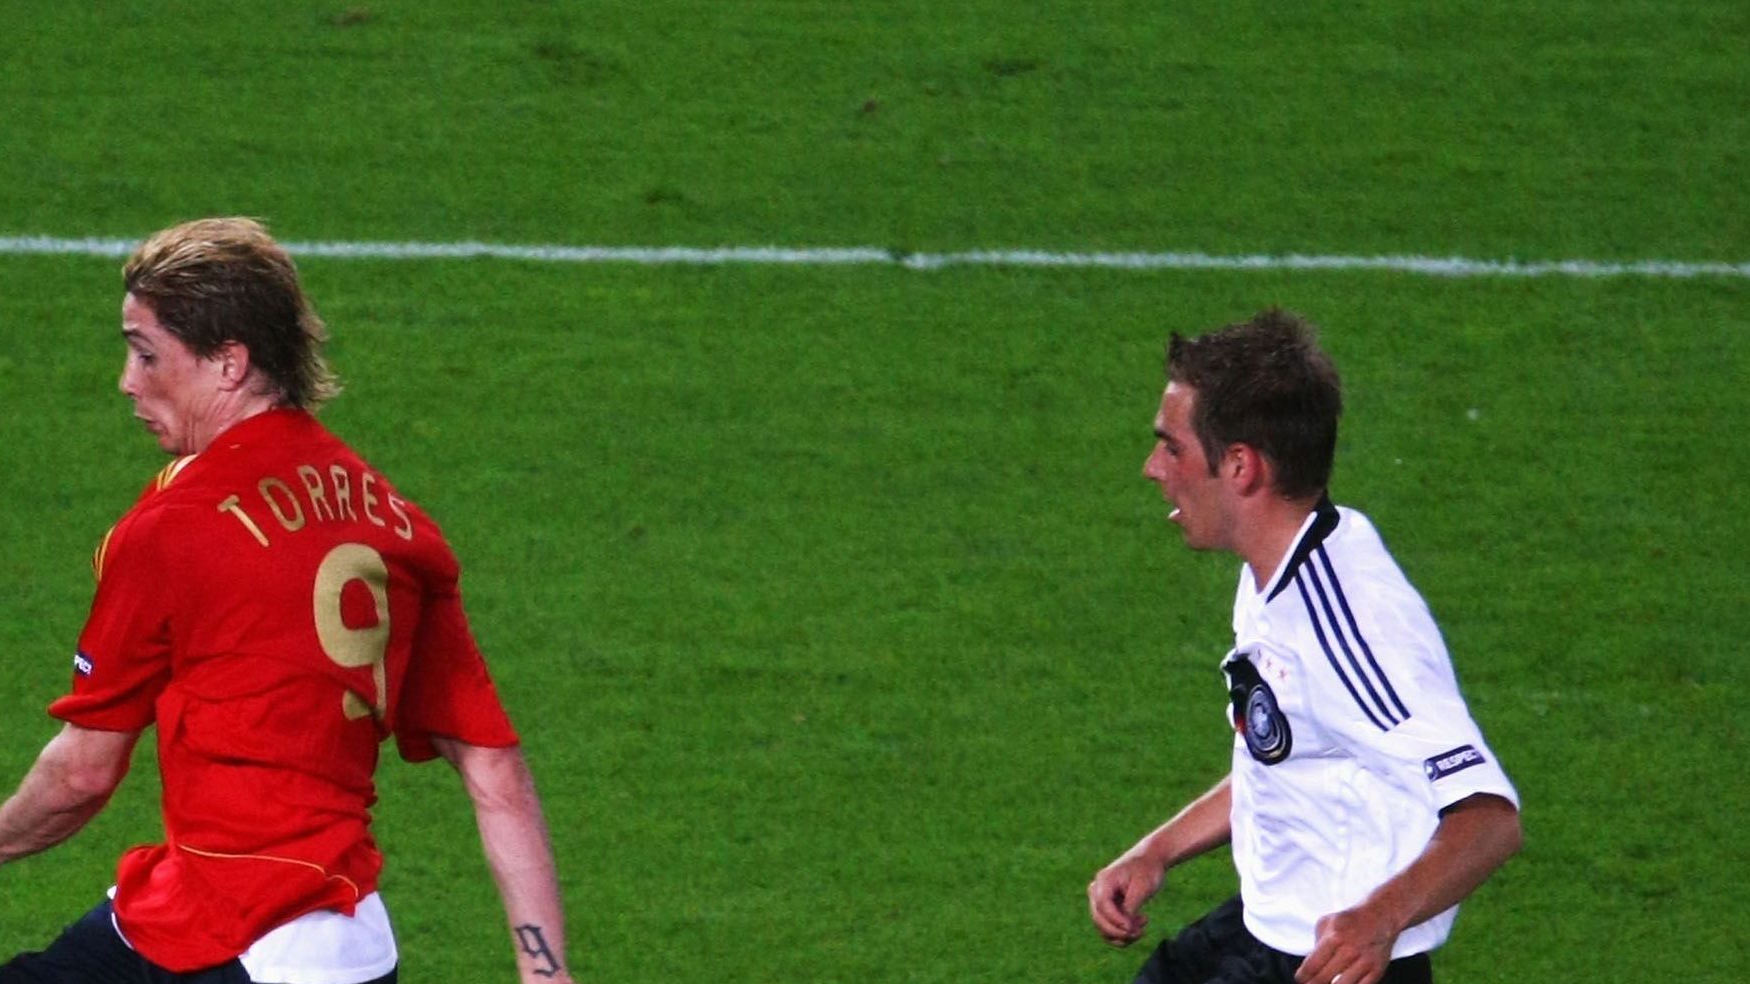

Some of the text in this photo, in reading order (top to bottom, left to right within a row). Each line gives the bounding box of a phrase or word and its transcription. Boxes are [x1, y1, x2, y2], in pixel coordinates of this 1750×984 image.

[217, 464, 413, 548] TORRES
[312, 542, 390, 721] 9
[514, 923, 562, 978] 9
